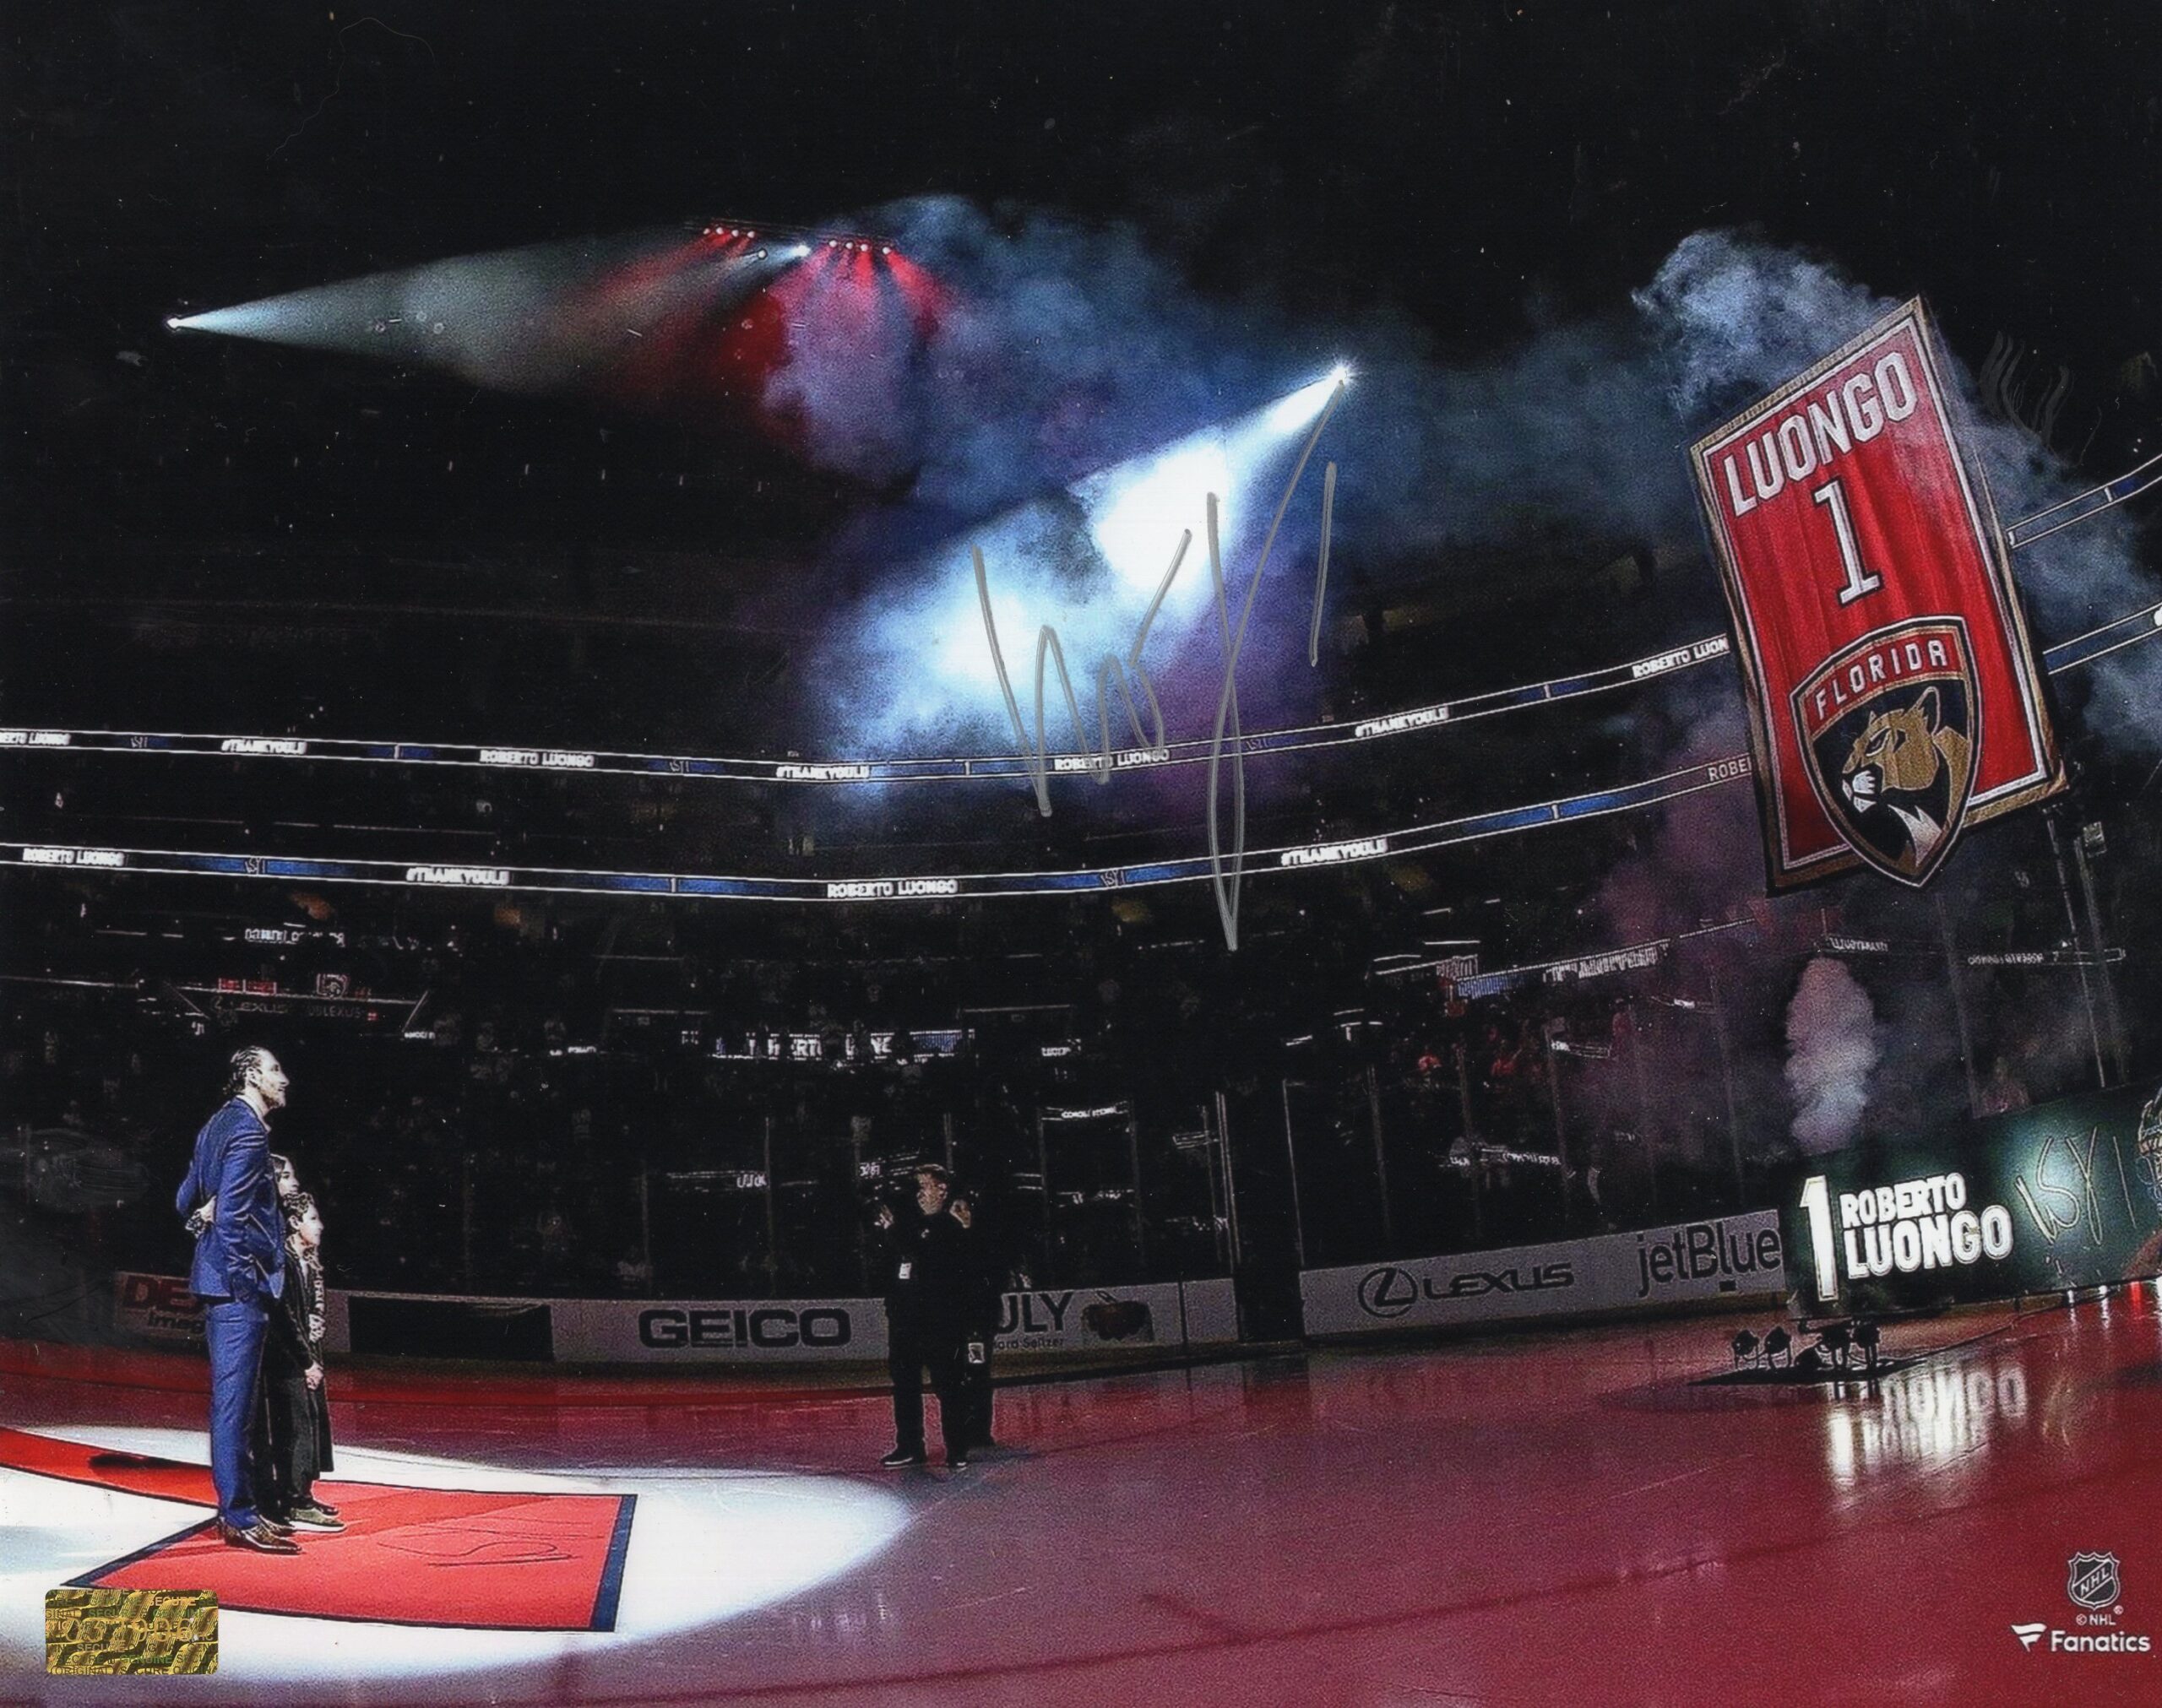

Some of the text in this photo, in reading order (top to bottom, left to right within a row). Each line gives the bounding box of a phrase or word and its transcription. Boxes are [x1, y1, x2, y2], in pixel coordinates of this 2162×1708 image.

[1723, 351, 1919, 518] LUONGO
[1814, 480, 1882, 605] 1
[1632, 651, 1691, 679] ROBERTO
[1815, 639, 1947, 720] FLORIDA
[479, 750, 595, 767] ROBERTO LUONGO
[1117, 748, 1170, 767] LUONGO
[23, 848, 125, 867] ROBERTO LUONGO
[828, 879, 959, 898] ROBERTO LUONGO
[1839, 1172, 1967, 1229] ROBERTO
[1637, 1223, 1783, 1298] jetBlue
[1800, 1174, 1839, 1302] 1
[1843, 1204, 2015, 1280] LUONGO
[1424, 1262, 1574, 1300] LEXUS
[638, 1308, 852, 1349] GEICO
